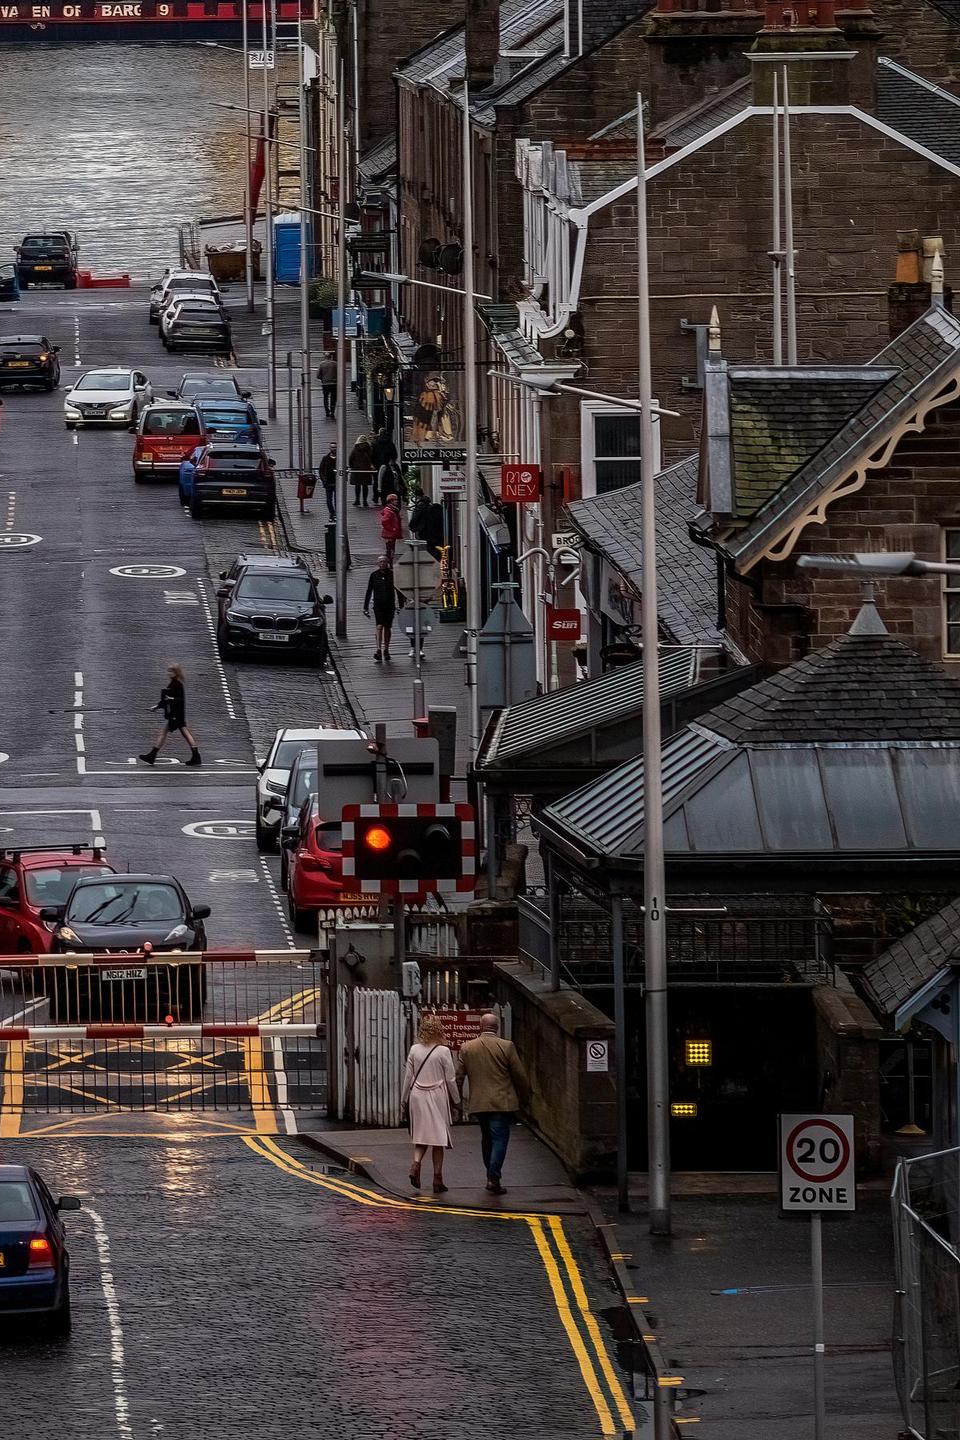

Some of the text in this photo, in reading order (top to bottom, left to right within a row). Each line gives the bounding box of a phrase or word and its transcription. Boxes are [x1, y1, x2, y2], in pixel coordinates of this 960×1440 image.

[159, 4, 169, 16] 9
[506, 484, 536, 497] NEY
[551, 620, 578, 629] Sun
[796, 1137, 841, 1164] 20
[789, 1186, 848, 1204] ZONE
